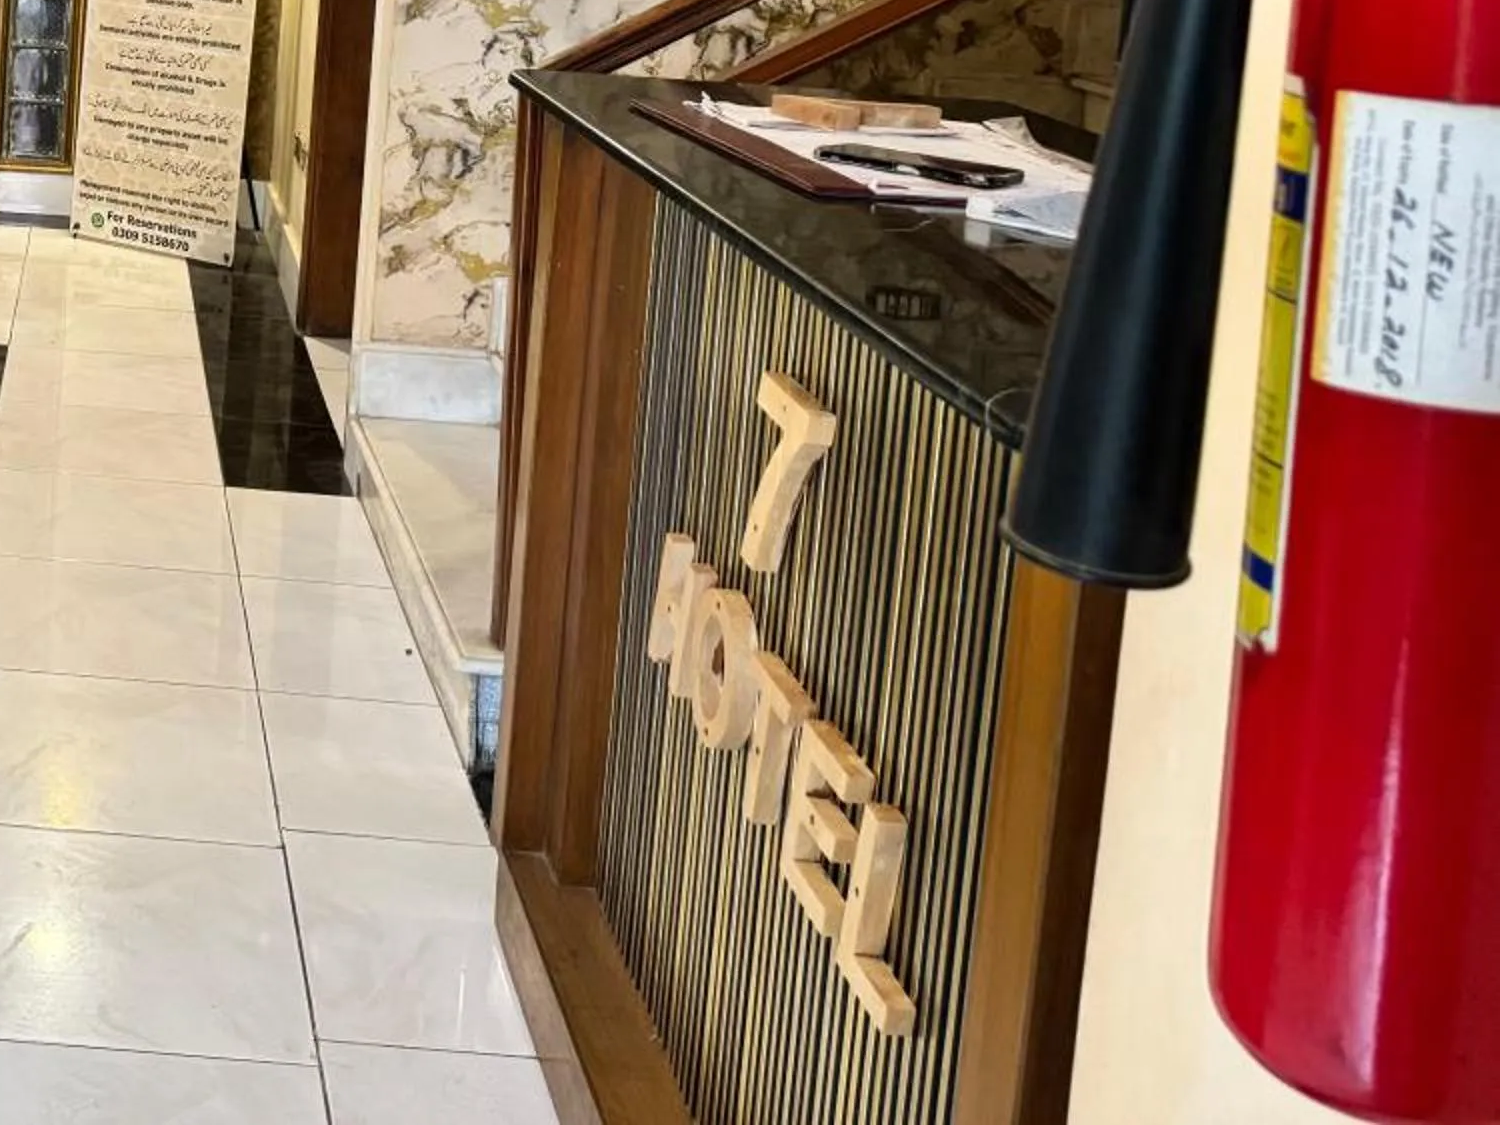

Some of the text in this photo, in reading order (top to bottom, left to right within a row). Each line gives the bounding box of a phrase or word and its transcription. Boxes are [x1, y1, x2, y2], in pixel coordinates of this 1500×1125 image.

[106, 210, 197, 239] For Reservations
[111, 225, 139, 241] 0309
[1426, 220, 1458, 301] NEW
[647, 531, 916, 1037] HOTEL
